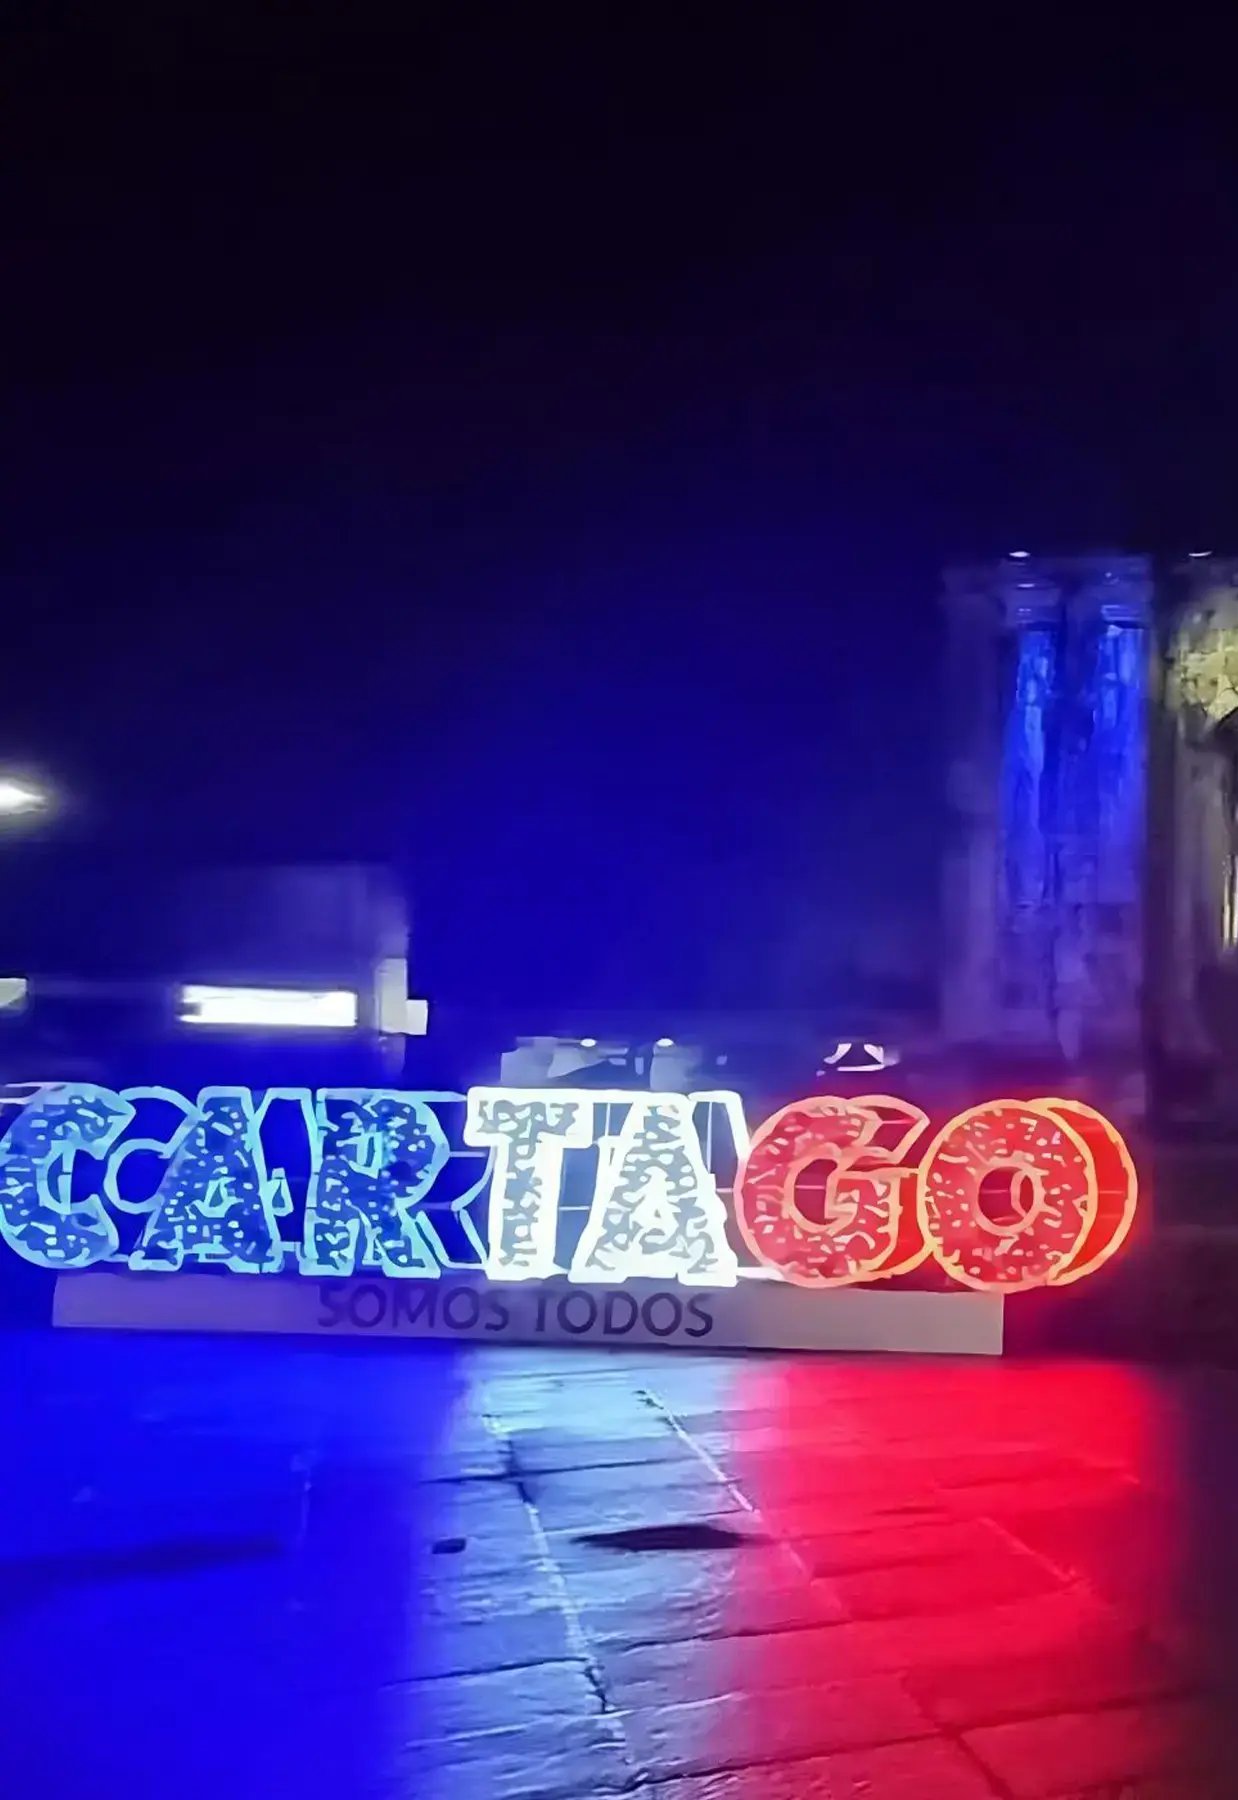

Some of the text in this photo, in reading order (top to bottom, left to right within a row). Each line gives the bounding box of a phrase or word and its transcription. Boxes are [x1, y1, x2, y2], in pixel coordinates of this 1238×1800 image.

[0, 1084, 1138, 1294] CARTAGO
[317, 1284, 714, 1338] SOMOS TODOS
